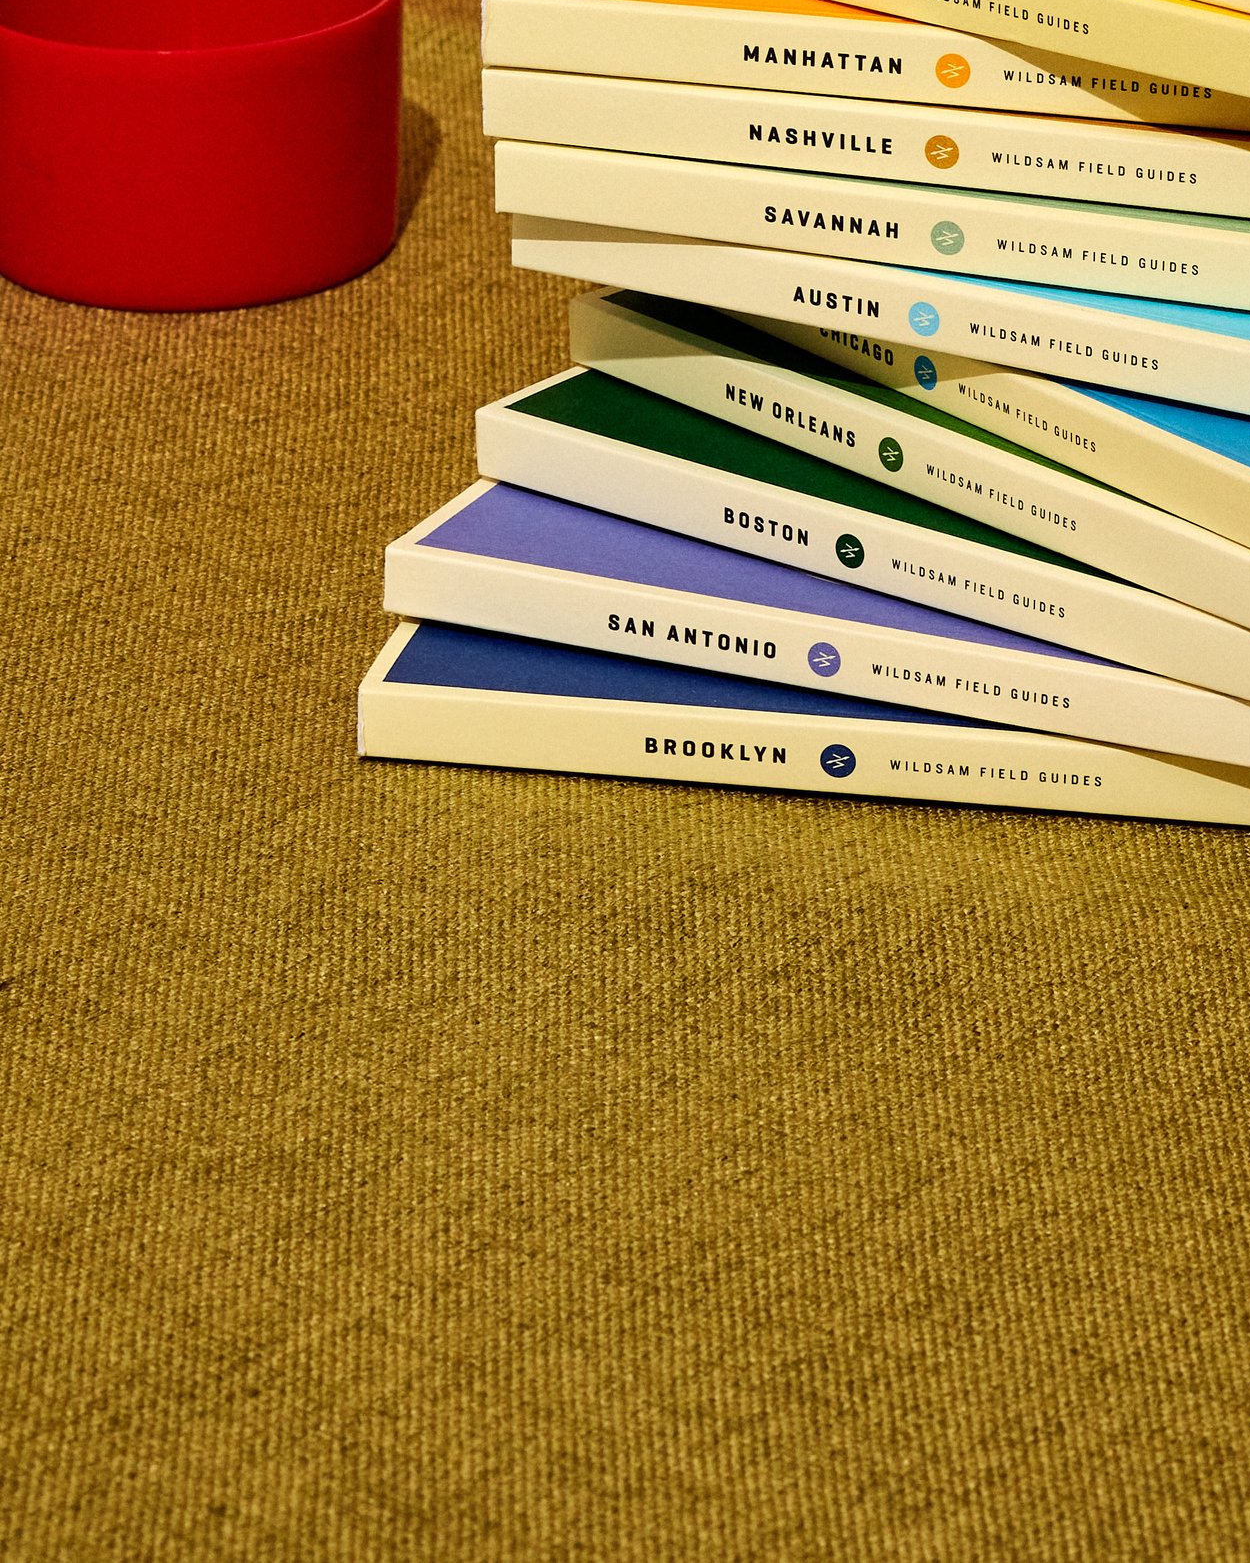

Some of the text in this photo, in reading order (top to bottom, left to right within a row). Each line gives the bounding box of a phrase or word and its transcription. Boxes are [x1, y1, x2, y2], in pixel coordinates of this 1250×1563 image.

[989, 1, 1029, 21] FIELD
[1037, 12, 1089, 35] GUIDES
[743, 44, 1213, 99] MANHATTAN WILDSAM FIELD GUIDES
[749, 124, 1197, 185] NASHVILLE WILDSAM FIELD GUIDES
[764, 205, 1199, 276] SAVANNAH WILDSAM FIELD GUIDES
[793, 285, 1159, 371] AUSTIN WILDSAM FIELD GUIDES
[958, 382, 1010, 415] WILDSAM
[1016, 408, 1048, 432] FIELD
[1054, 425, 1096, 453] GUIDES
[725, 383, 1077, 532] NEW ORLEANS WILDSAM FIELD GUIDES
[724, 506, 1065, 619] BOSTON WILDSAM FIELD GUIDES
[607, 613, 1070, 709] SAN ANTONIO WILDSAM FIELD GUIDES
[645, 736, 1102, 787] BROOKLYN WILDSAM FIELD GUIDES
